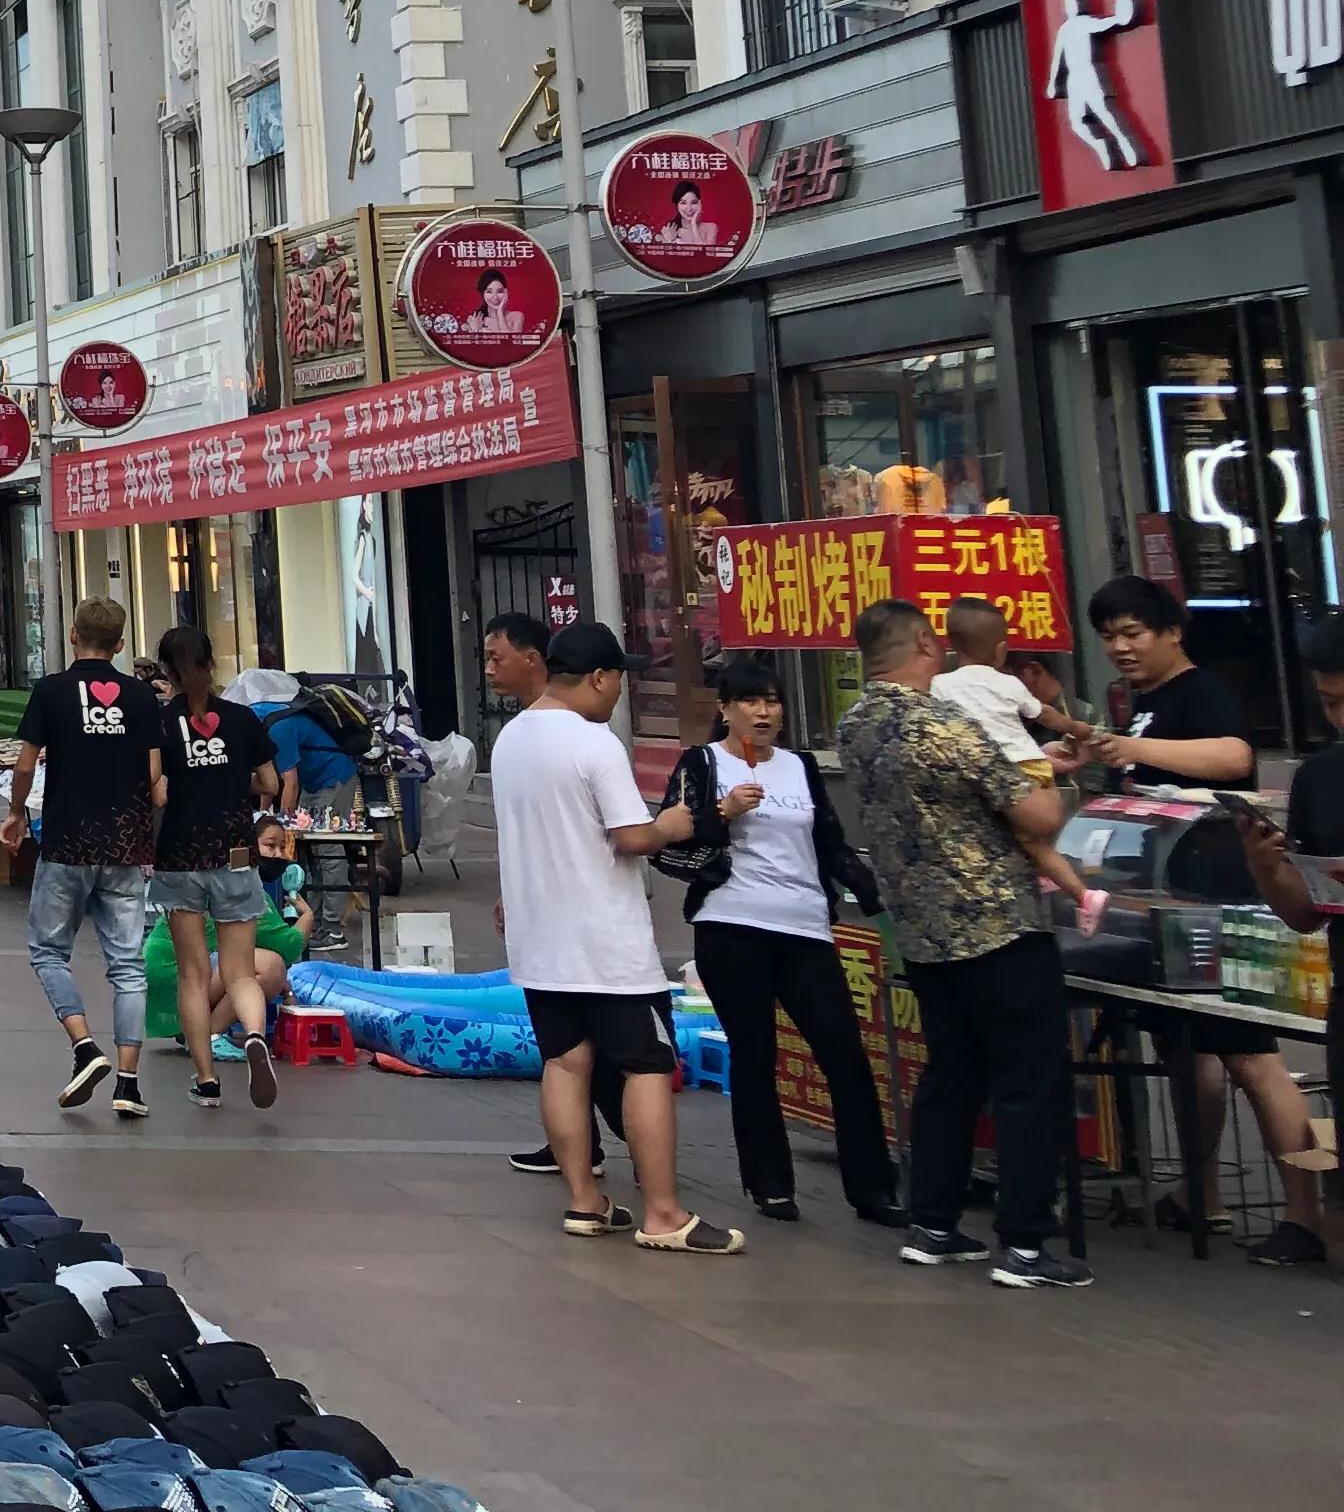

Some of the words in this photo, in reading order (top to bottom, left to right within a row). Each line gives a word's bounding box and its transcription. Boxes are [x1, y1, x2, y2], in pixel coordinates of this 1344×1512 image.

[631, 151, 729, 172] 六桂福珠宝
[436, 240, 536, 259] 六桂福珠宝
[73, 352, 133, 365] 六桂福珠宝
[343, 367, 515, 439] 黑河市市场监督管理局
[519, 386, 540, 428] 宣
[347, 415, 522, 483] 黑河市城市管理综合执法局
[66, 458, 111, 517] 扫黑恶
[121, 445, 174, 510] 净环境
[188, 430, 247, 501] 护稳定
[262, 411, 334, 489] 保平安
[914, 527, 1050, 578] 三元1根
[736, 529, 892, 638] 秘制烤肠
[550, 604, 580, 625] 特步
[919, 590, 1058, 640] 五2根
[82, 706, 124, 725] ice
[83, 724, 126, 735] cream
[185, 737, 226, 759] ice
[186, 753, 229, 768] cream
